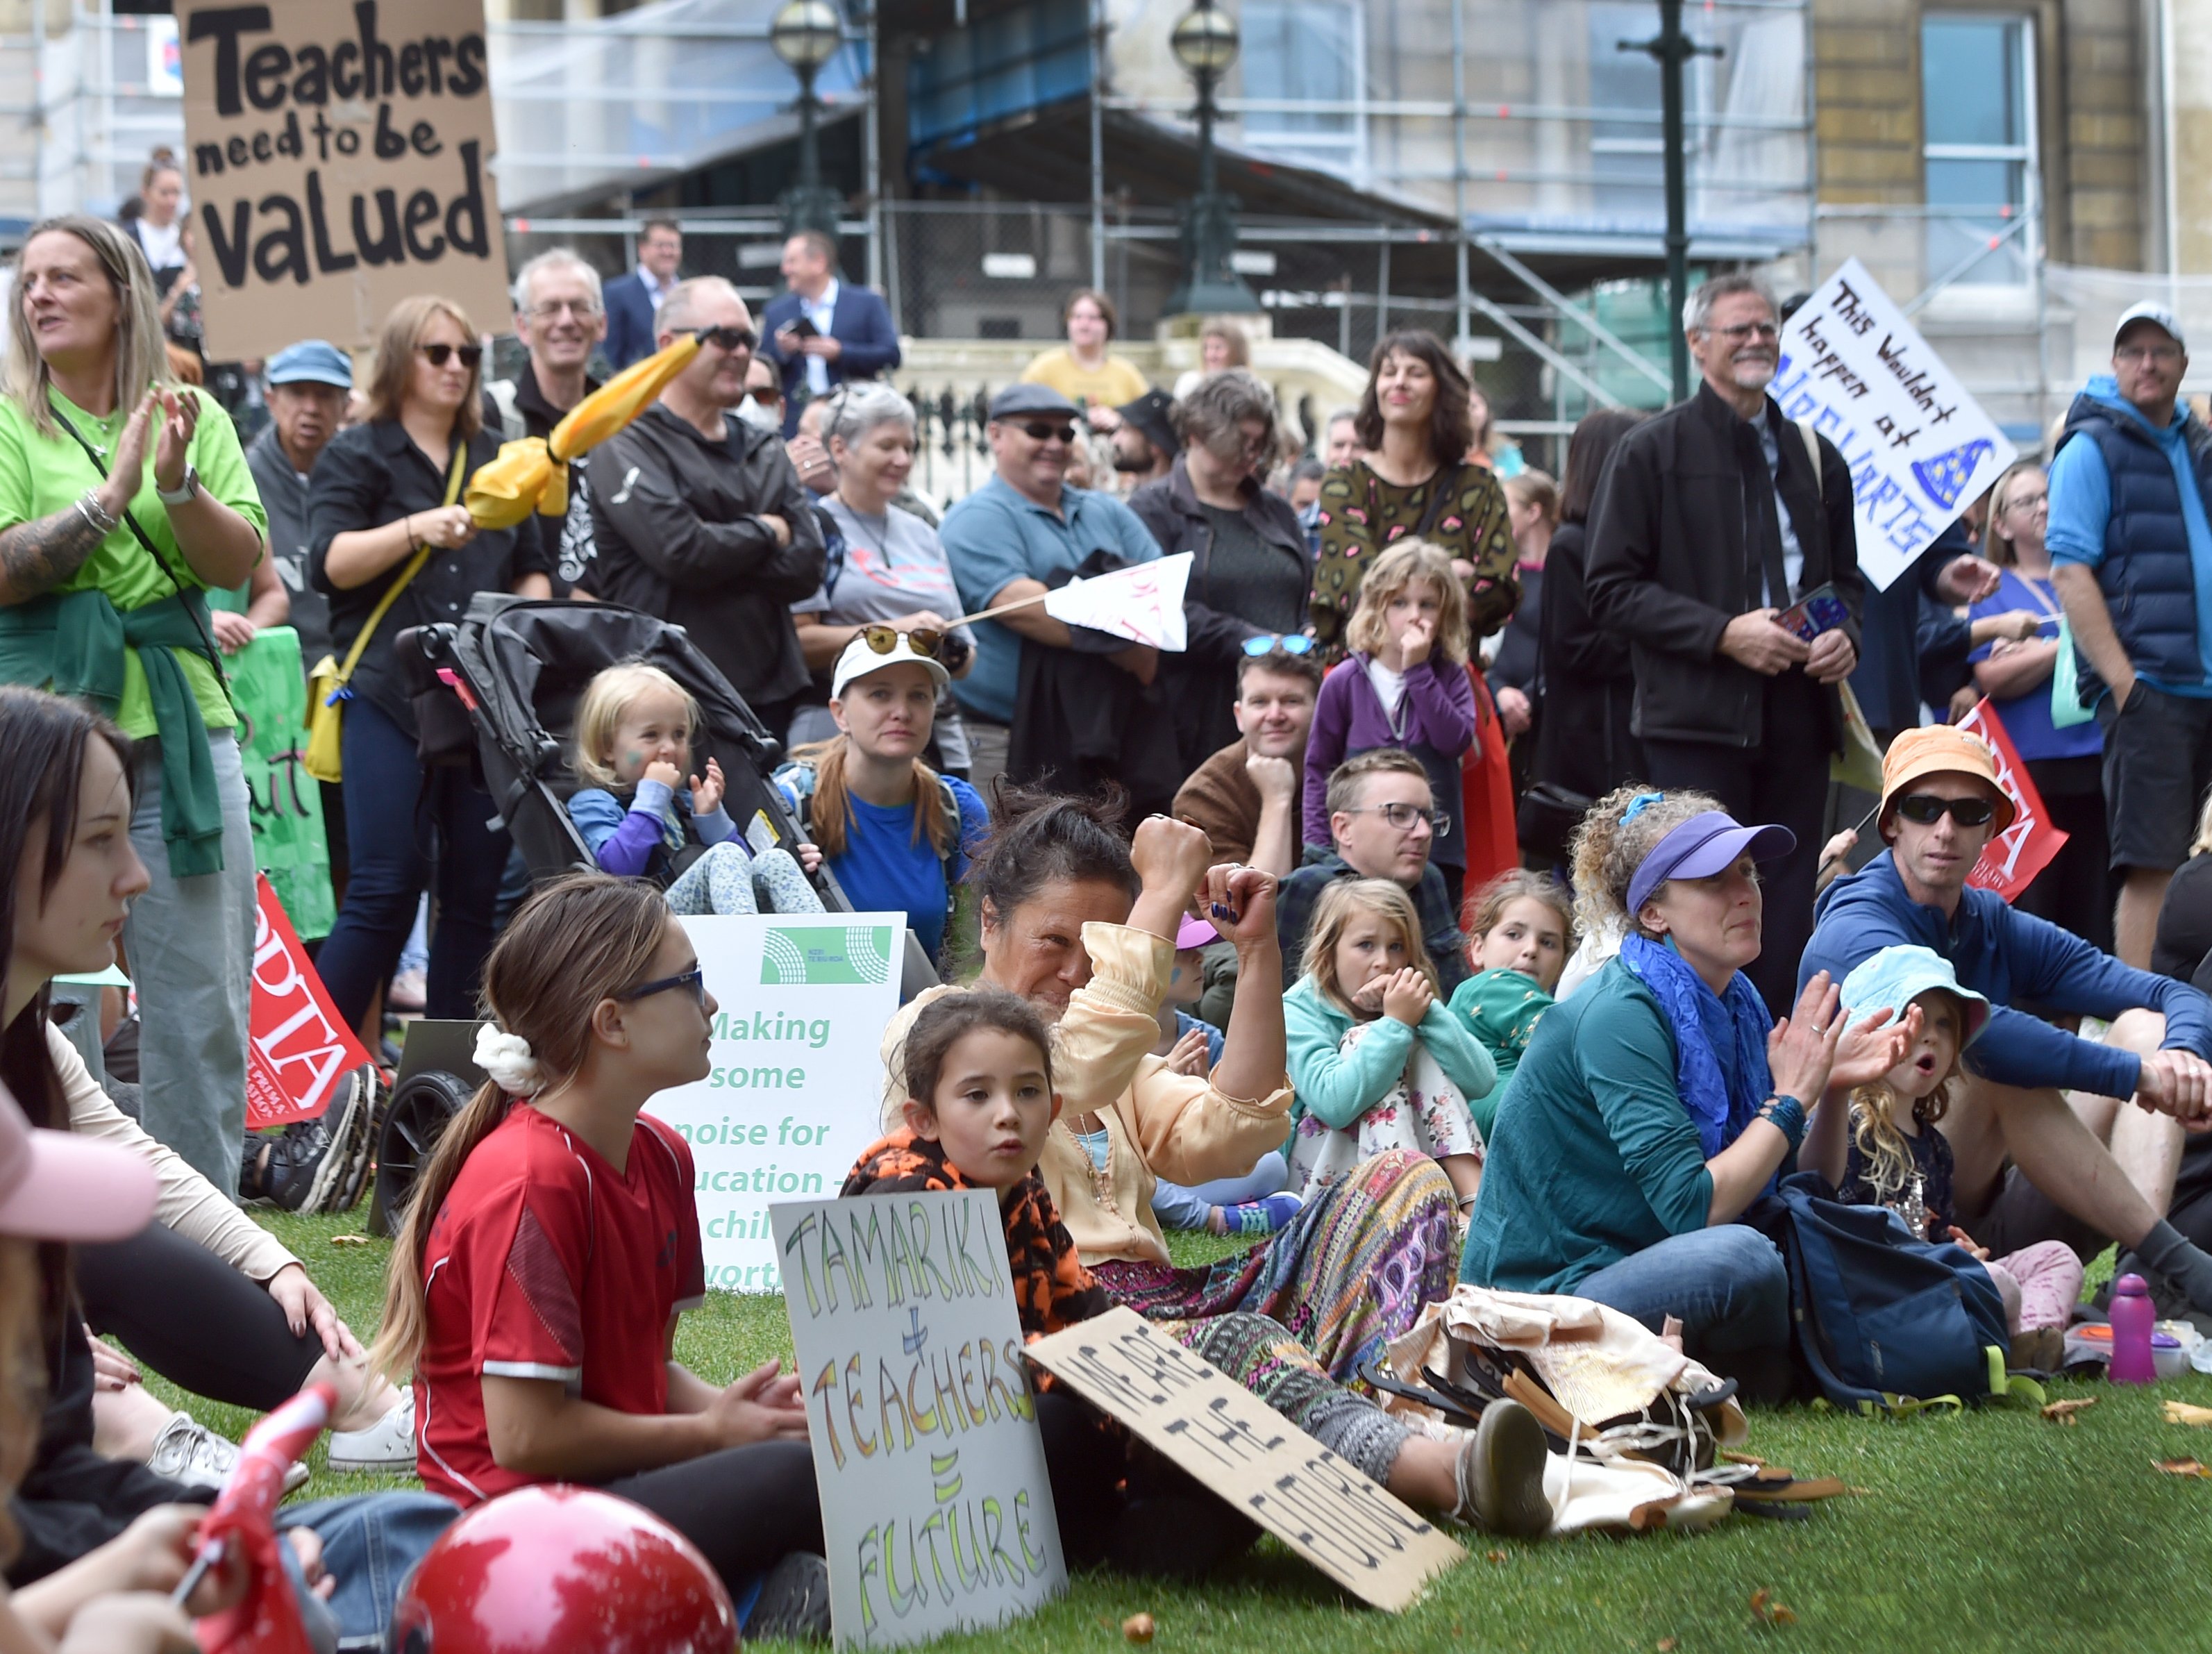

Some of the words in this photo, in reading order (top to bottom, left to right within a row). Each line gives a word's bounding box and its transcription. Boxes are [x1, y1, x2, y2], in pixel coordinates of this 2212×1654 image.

[188, 1, 485, 116] Teachers
[194, 110, 303, 176] need
[312, 112, 362, 161] to
[375, 103, 442, 158] be
[1831, 281, 1876, 336] This
[1798, 315, 1870, 400] happen
[1873, 415, 1921, 449] at
[252, 1069, 290, 1114] PRIMA
[710, 1067, 805, 1089] some
[674, 1116, 768, 1145] noise
[778, 1116, 830, 1146] for
[694, 1164, 822, 1193] ucation
[707, 1210, 771, 1239] chil
[785, 1197, 1005, 1319] TAMARIKI
[1056, 1346, 1168, 1417] WE
[1109, 1325, 1214, 1396] ARE
[812, 1338, 1035, 1472] TEACHERS
[1164, 1397, 1286, 1469] THE
[1250, 1451, 1433, 1580] FUTURE
[859, 1488, 1047, 1635] FUTURE
